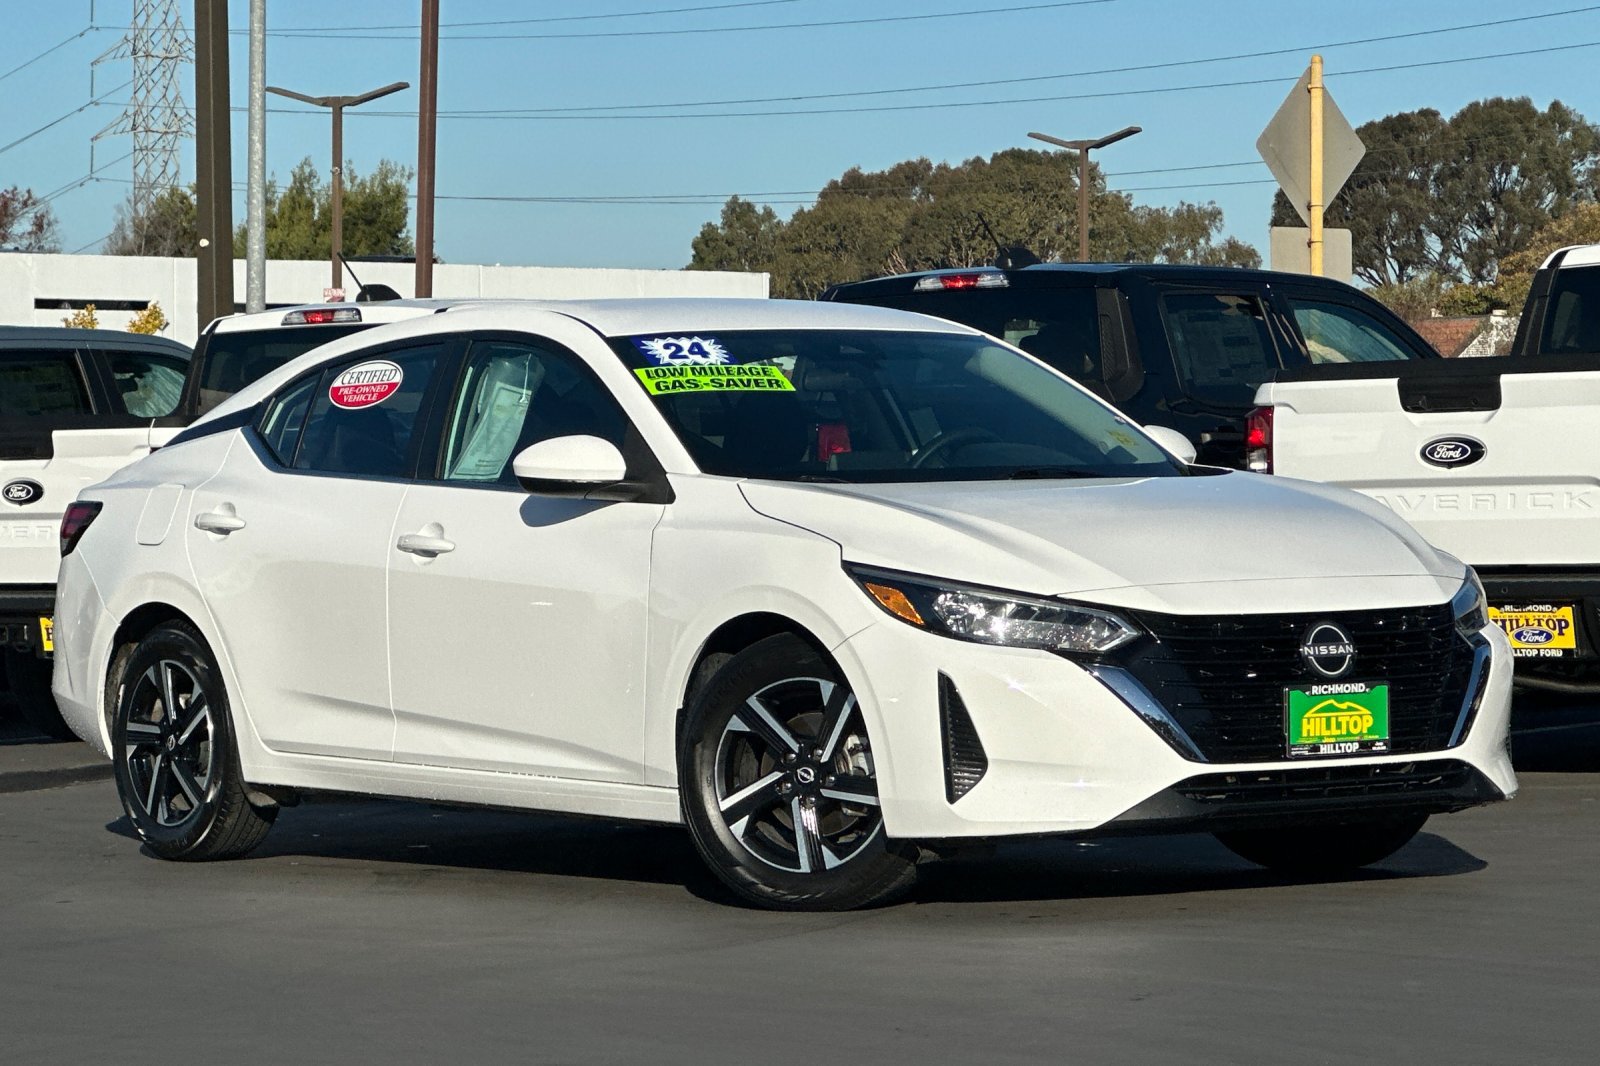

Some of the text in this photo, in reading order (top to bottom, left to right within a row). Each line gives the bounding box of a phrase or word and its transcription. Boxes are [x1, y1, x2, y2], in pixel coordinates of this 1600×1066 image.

[662, 341, 711, 360] 24
[341, 368, 398, 385] CERTIFIED
[645, 366, 775, 380] LOW MILEAGE
[338, 384, 389, 395] PRE-OWNED
[343, 393, 378, 402] VEHICLE
[1433, 444, 1462, 459] Ford
[8, 486, 27, 498] Ford
[1375, 491, 1593, 512] AVERICK
[1491, 618, 1569, 636] HILLTOP
[1520, 630, 1546, 642] Ford
[1304, 645, 1353, 655] NISSAN
[1513, 648, 1563, 657] LLTOP FORD
[1311, 683, 1366, 695] RICHMOND
[1302, 715, 1374, 737] HILLTOP
[1319, 742, 1359, 754] HILLTOP
